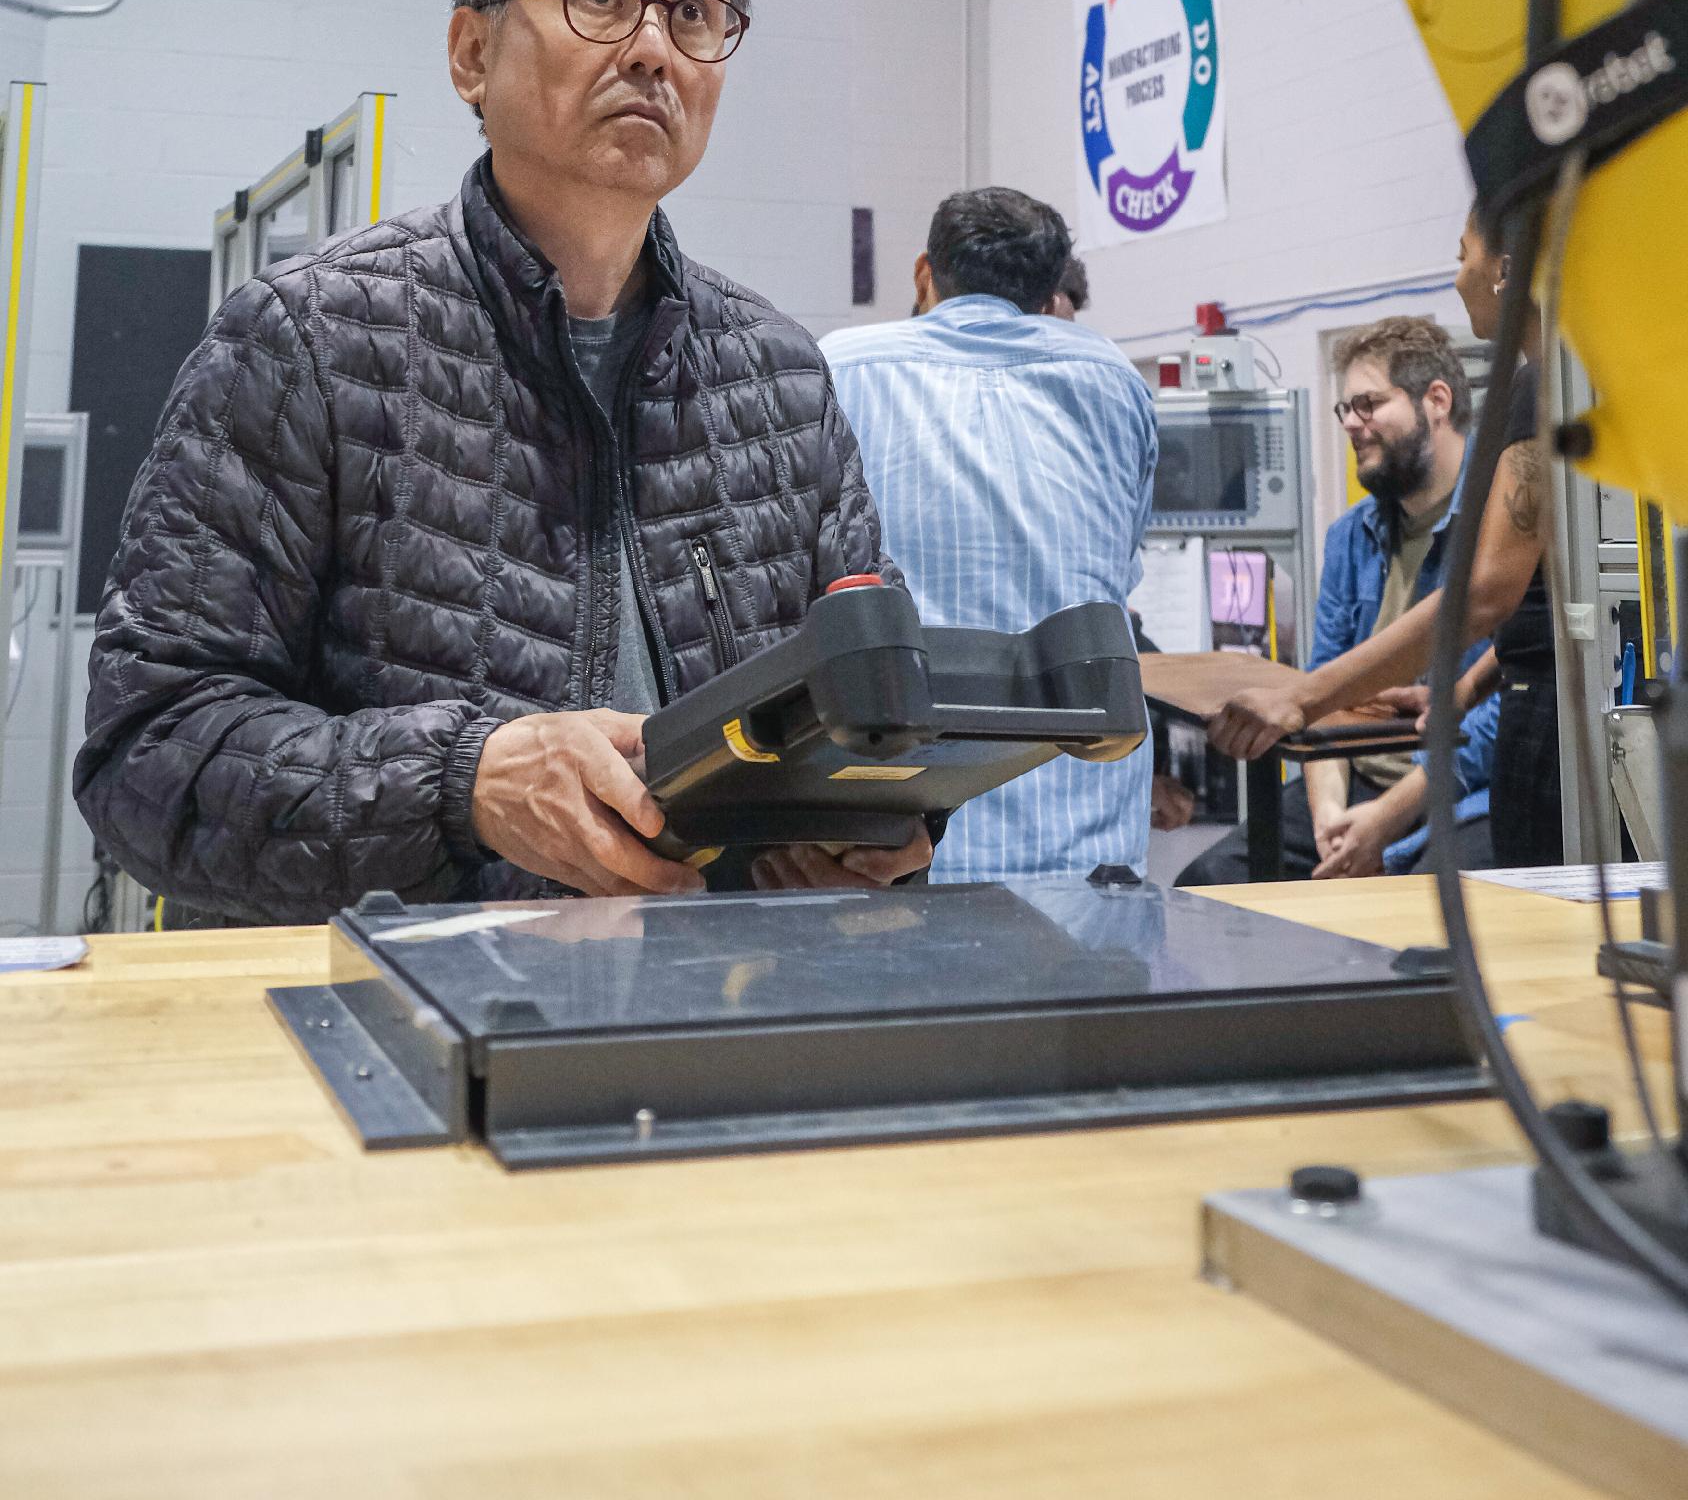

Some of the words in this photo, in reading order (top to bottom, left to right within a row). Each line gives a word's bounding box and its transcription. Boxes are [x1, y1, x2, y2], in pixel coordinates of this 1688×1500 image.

[1108, 31, 1181, 80] MANUFACTURING
[1193, 18, 1213, 86] DO
[1084, 62, 1103, 134] ACT
[1125, 73, 1165, 108] PROCESS
[1114, 172, 1180, 221] CHECK
